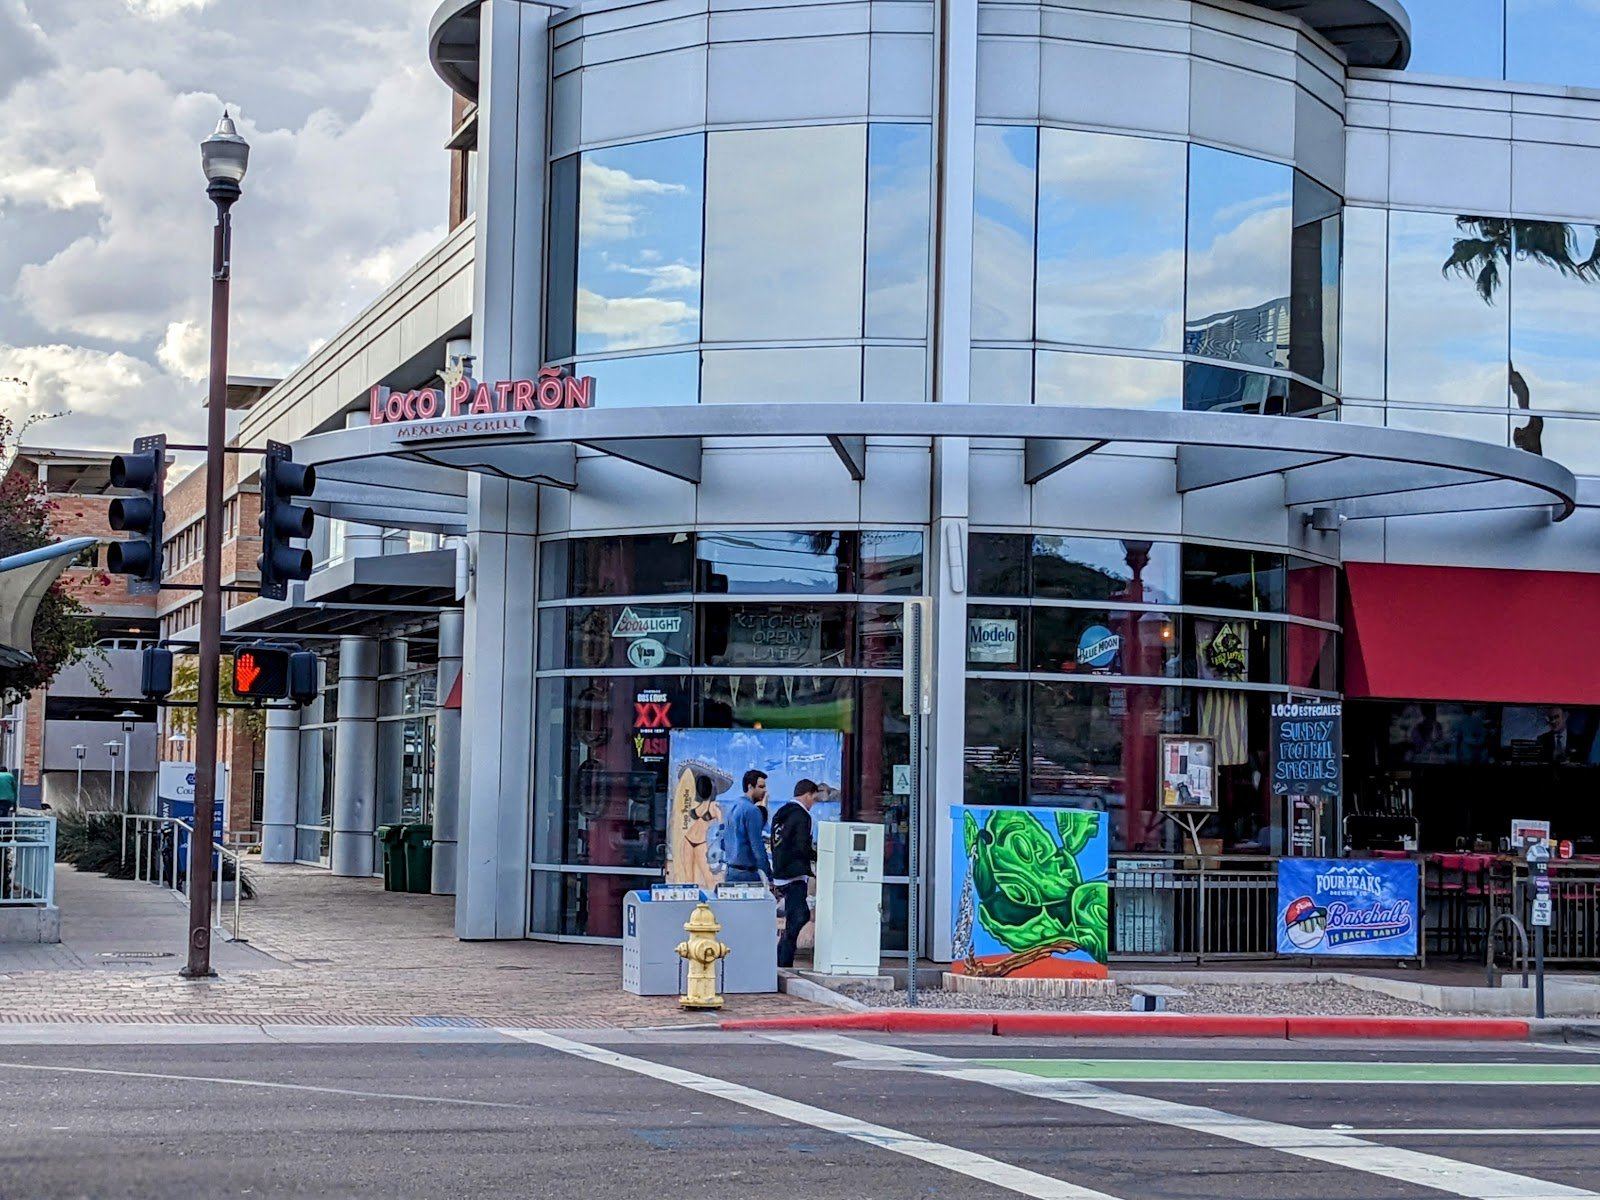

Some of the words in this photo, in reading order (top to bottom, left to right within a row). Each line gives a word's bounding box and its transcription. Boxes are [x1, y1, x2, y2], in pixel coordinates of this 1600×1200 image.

[397, 422, 468, 438] MEXICAN
[473, 418, 521, 433] GRILL
[618, 615, 649, 632] Coors
[650, 618, 679, 631] LIGHT
[735, 613, 820, 629] KITCHEN
[752, 630, 801, 644] OPEN
[970, 625, 1015, 643] Modelo
[1080, 645, 1098, 661] BLUE
[1098, 636, 1118, 653] MOON
[633, 702, 672, 728] XX
[1271, 704, 1299, 717] LOCO
[1299, 705, 1341, 717] ESPECIALES
[1280, 721, 1334, 741] SUNDAY
[1280, 741, 1336, 760] FOOTBALL
[897, 772, 909, 786] A
[1275, 760, 1338, 779] SPECIALS
[1316, 874, 1345, 895] FOUR
[1345, 875, 1381, 896] PEAKS
[1327, 901, 1410, 927] Baseball
[1331, 933, 1340, 944] IS
